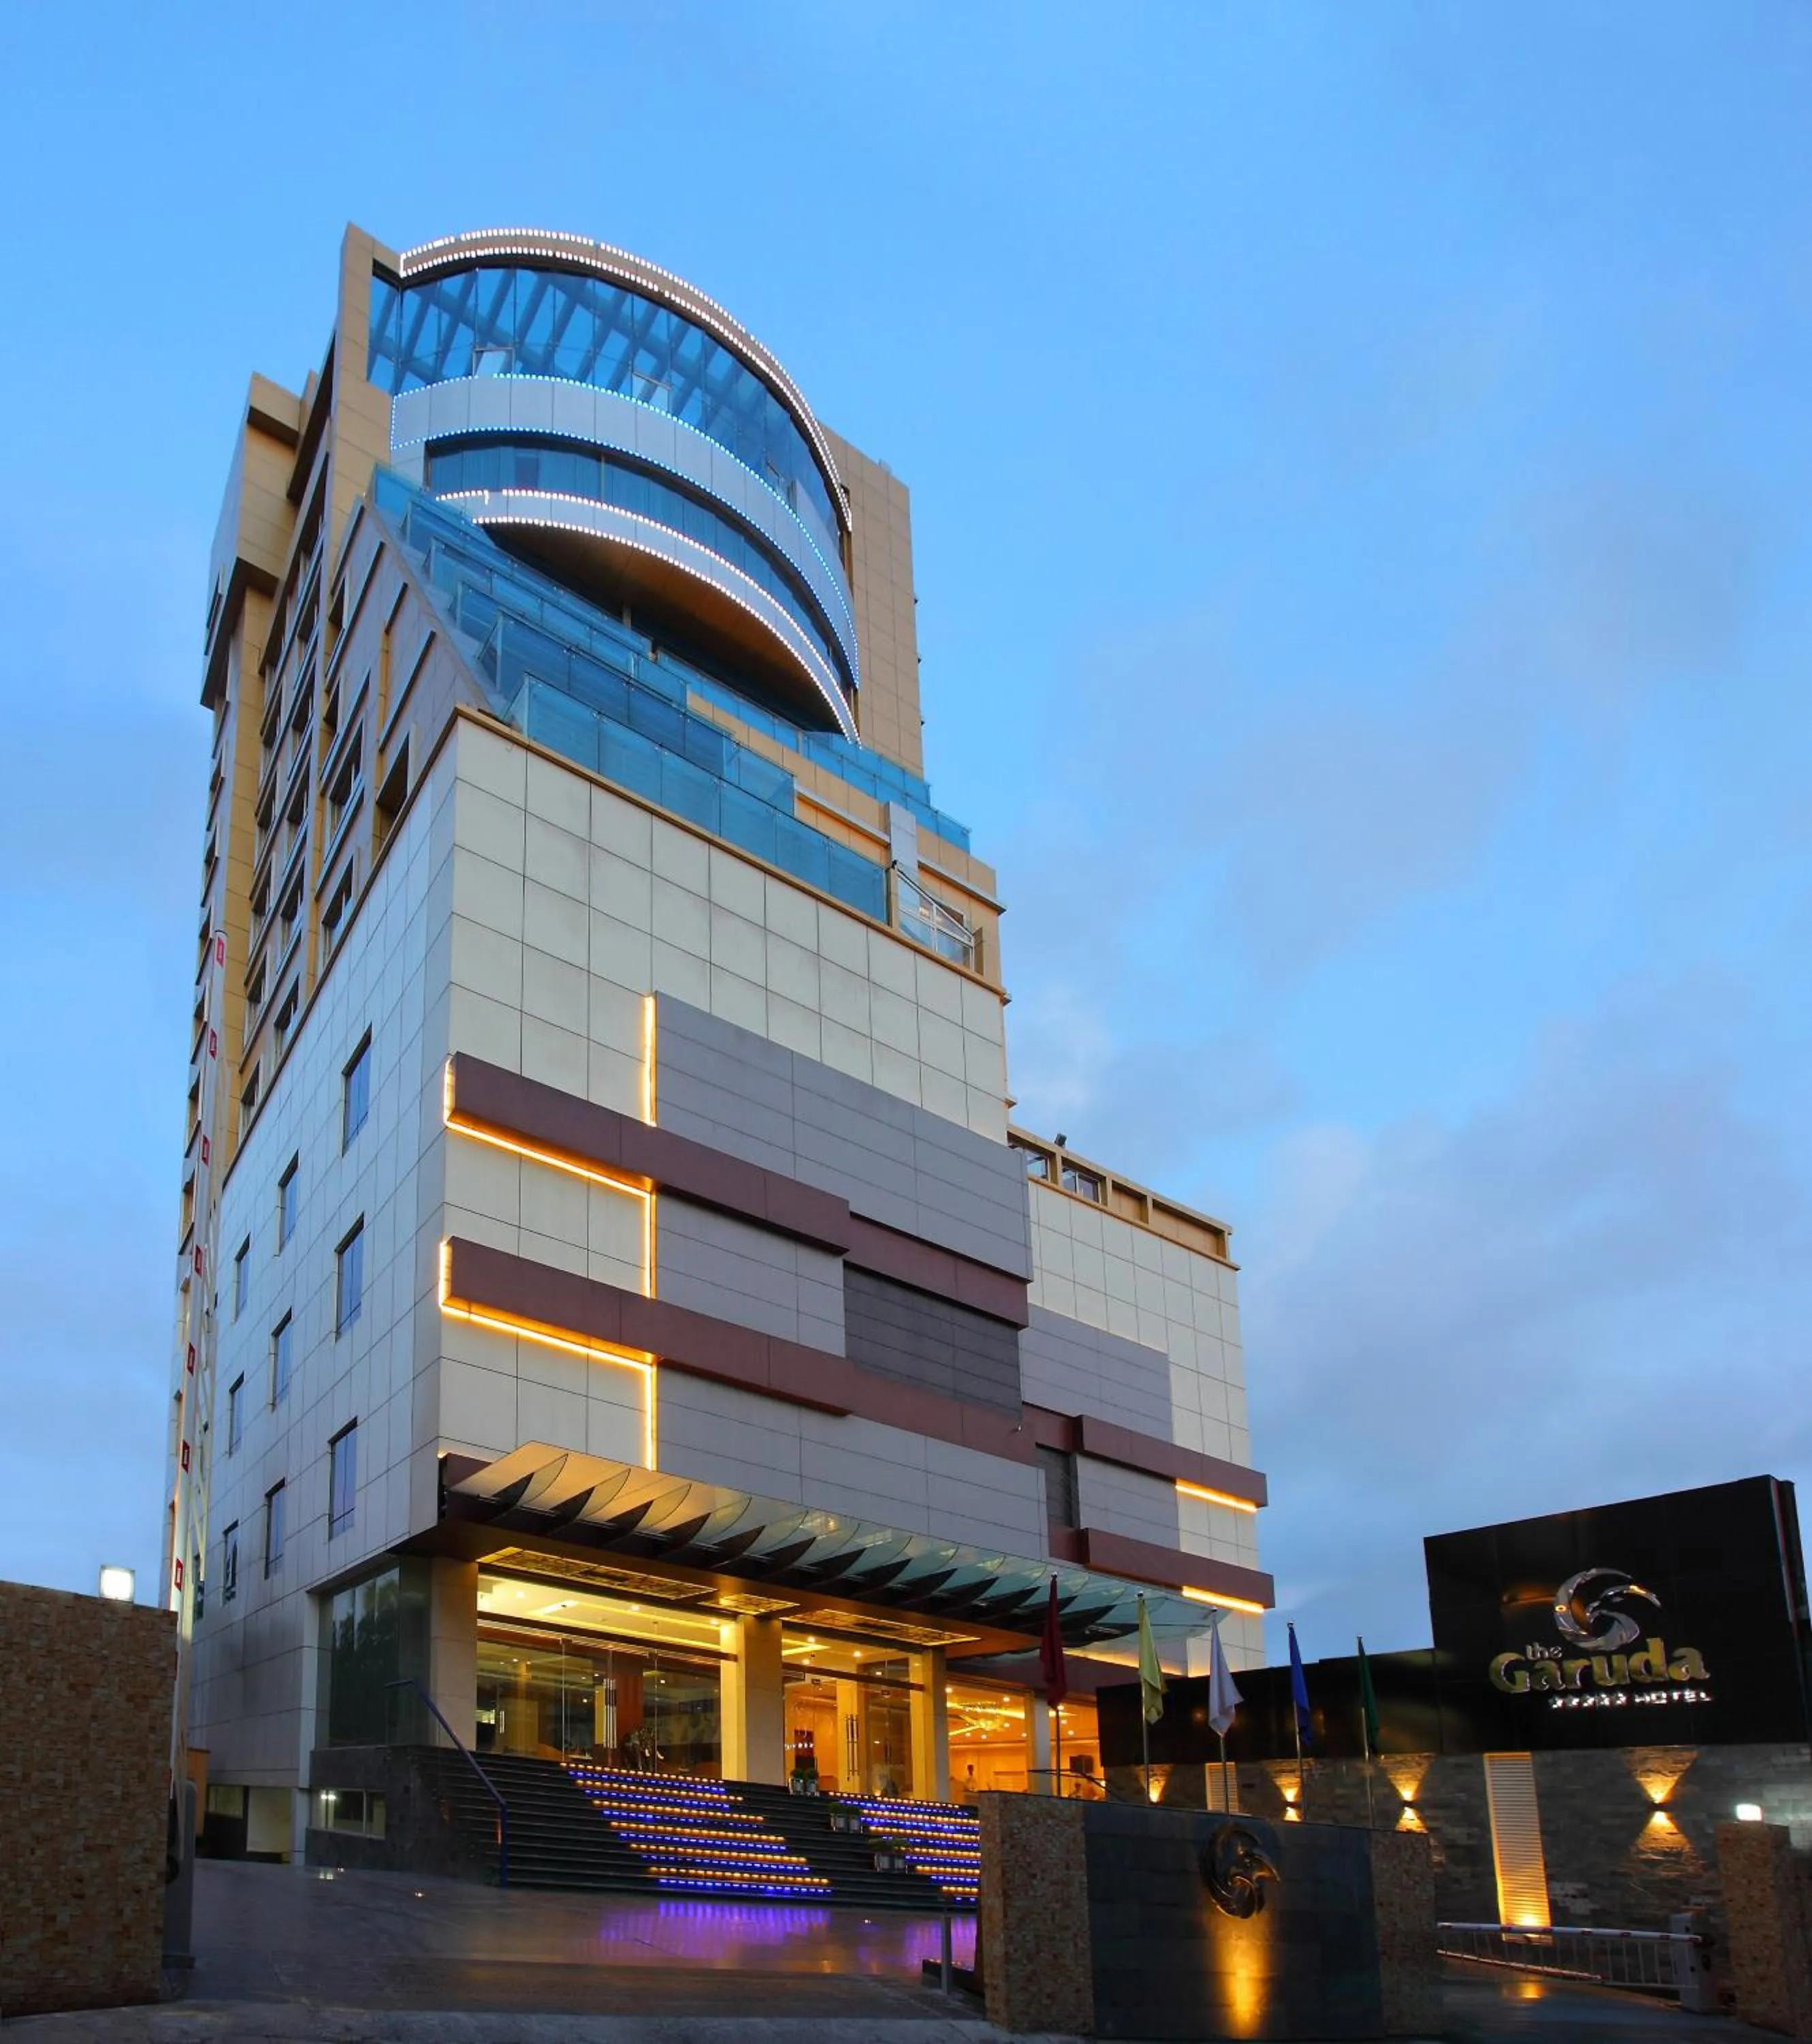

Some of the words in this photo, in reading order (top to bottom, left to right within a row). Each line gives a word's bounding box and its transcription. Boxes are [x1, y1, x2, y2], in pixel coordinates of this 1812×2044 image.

[1525, 1642, 1563, 1660] the
[1489, 1637, 1711, 1694] Garuda
[1635, 1689, 1712, 1703] HOTEL
